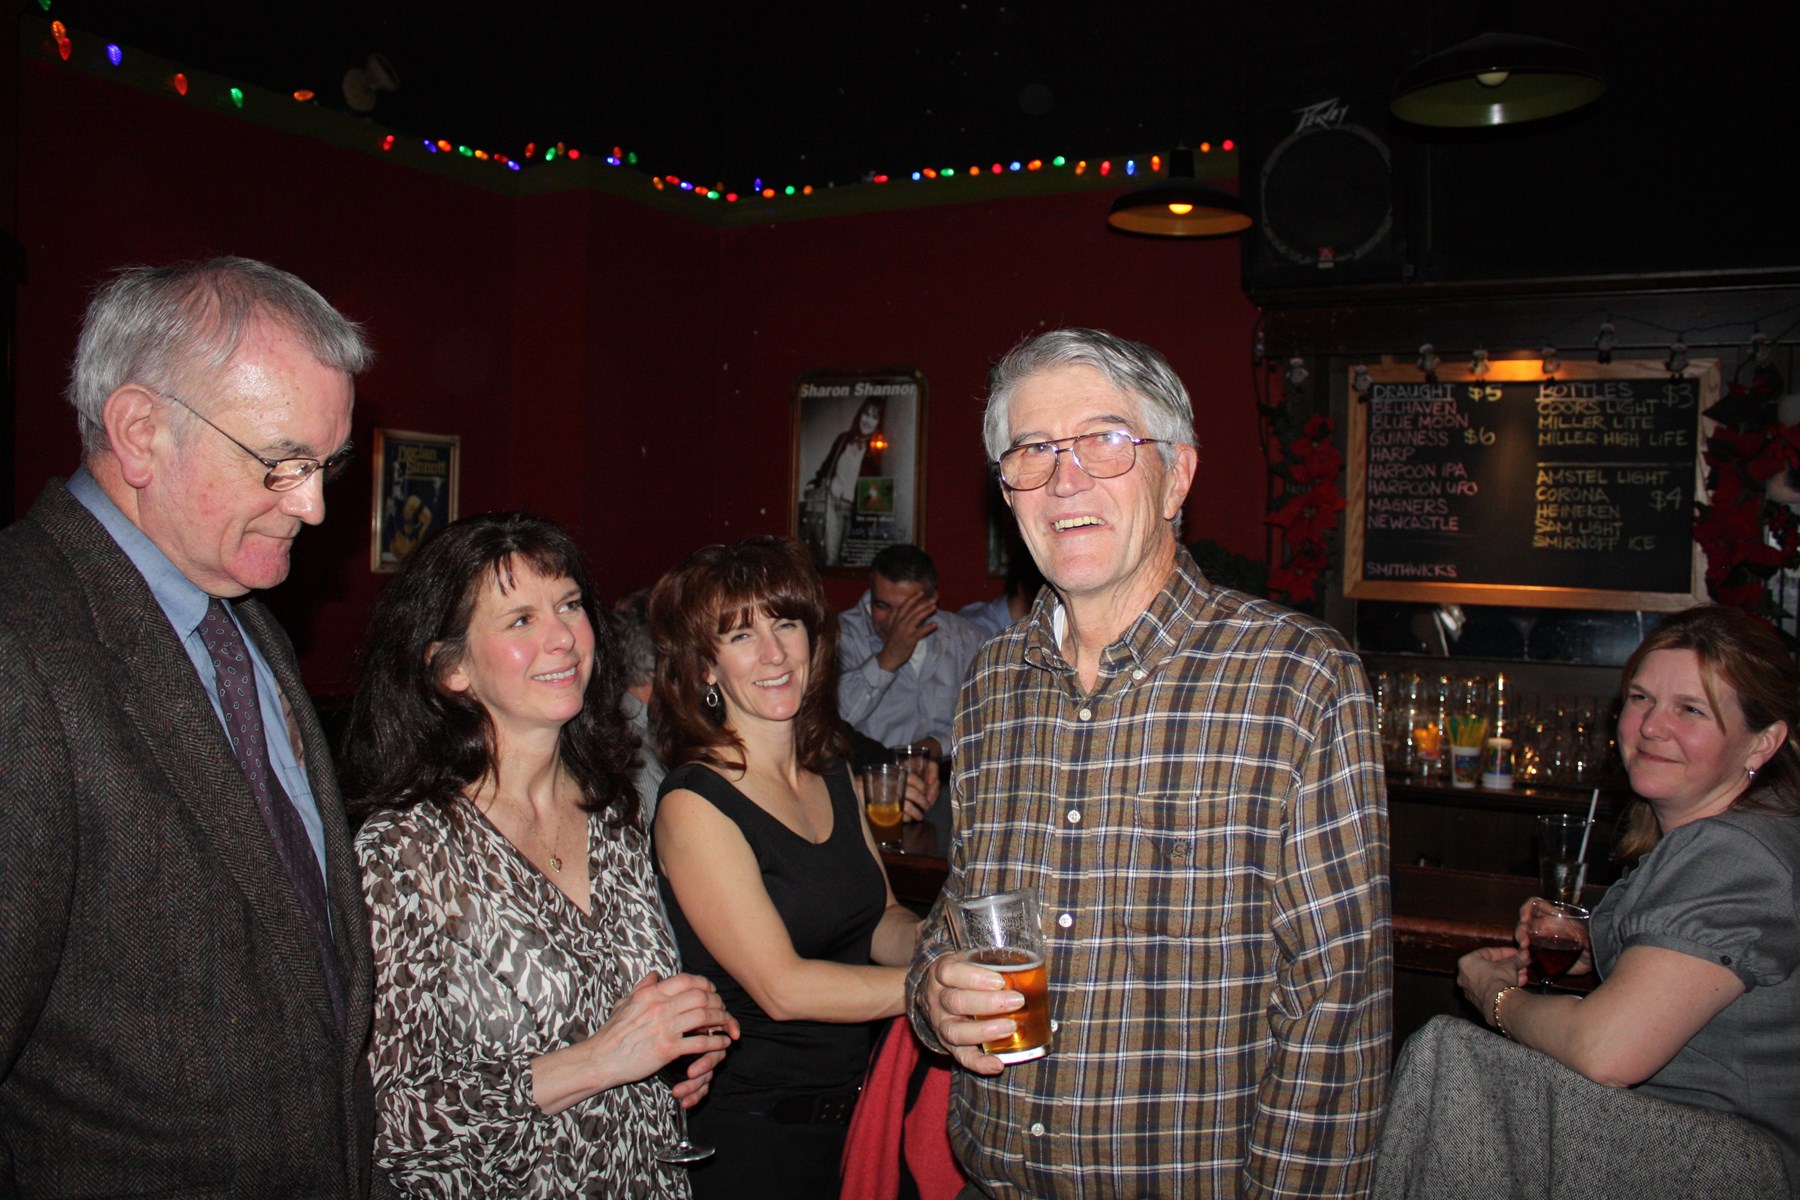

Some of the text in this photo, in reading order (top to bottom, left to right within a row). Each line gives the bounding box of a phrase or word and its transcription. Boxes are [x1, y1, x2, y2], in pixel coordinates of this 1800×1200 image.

[800, 382, 917, 398] Sharon Shannon
[1372, 384, 1503, 402] DRAUGHT $5
[1662, 383, 1694, 409] $3
[1371, 401, 1457, 416] BELHAVEN
[1537, 399, 1660, 415] COORS LIGHT
[1371, 413, 1469, 430] BLUE MOON
[1537, 415, 1655, 431] MILLER LITE
[1370, 427, 1496, 446] GUINNESS $6
[1537, 430, 1688, 448] MILLER HIGH LIFE
[1371, 447, 1415, 462] HARP
[1368, 462, 1468, 479] HARPOON IPA
[1535, 469, 1669, 486] AMSTEL LIGHT
[1368, 480, 1479, 497] HARPOON UFO
[1368, 499, 1449, 515] MAGNERS
[1535, 486, 1683, 511] CORONA $4
[1535, 504, 1620, 520] HEINEKEN
[1367, 515, 1459, 531] NEWCASTLE
[1534, 519, 1624, 537] SAM LIGHT
[1532, 534, 1656, 551] SMIRNOFF ICE
[1366, 562, 1458, 578] SMITHWICKS
